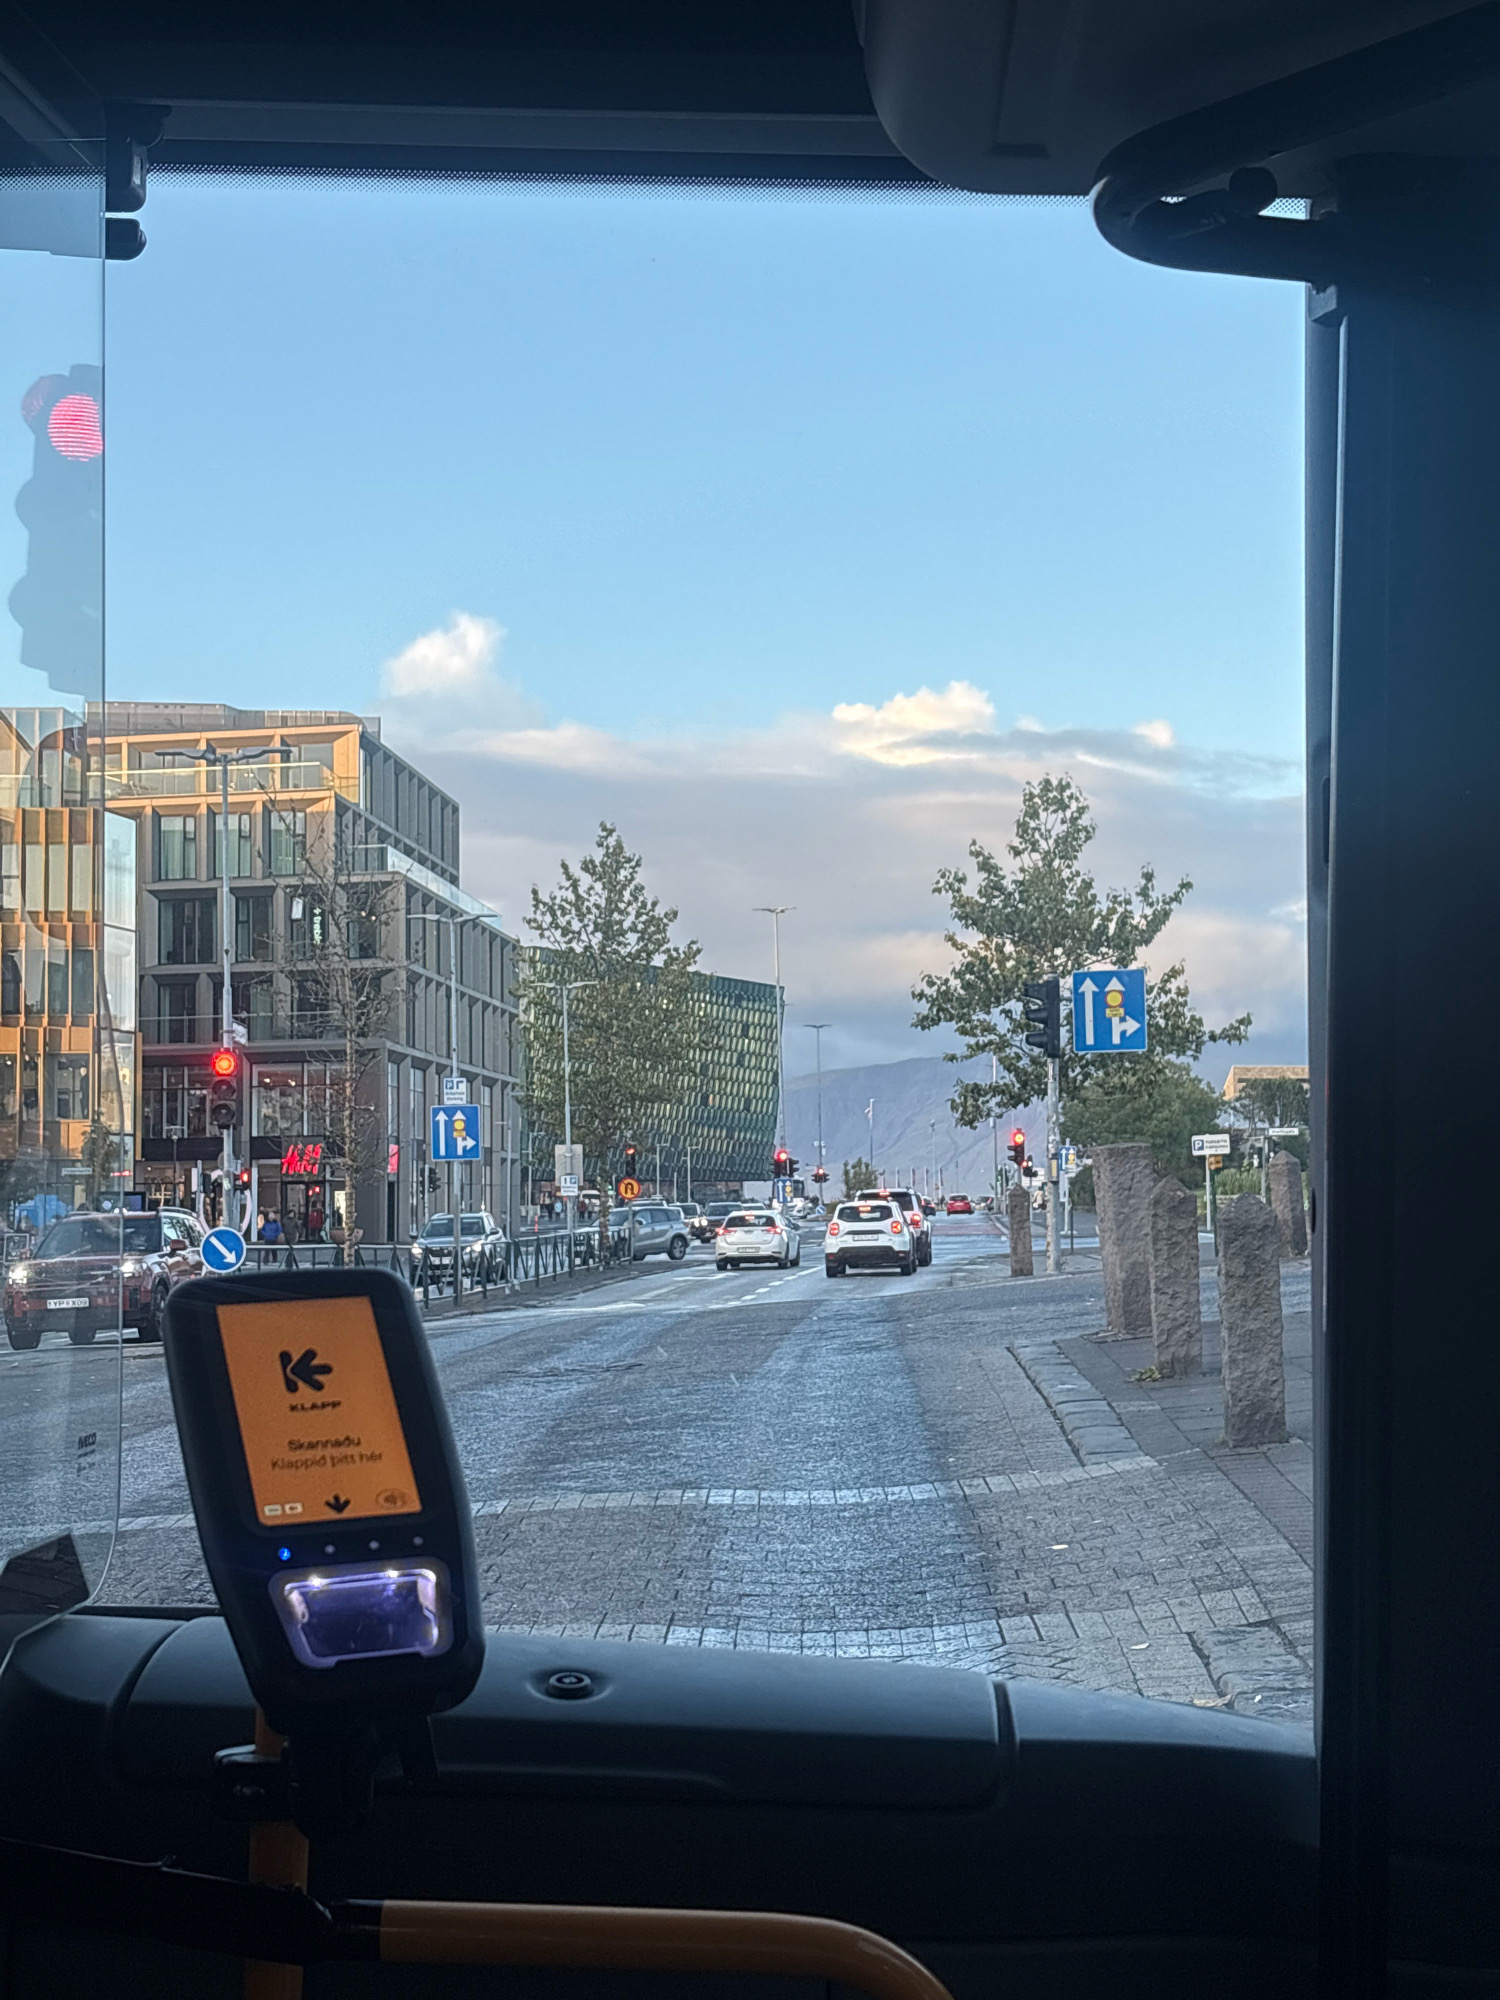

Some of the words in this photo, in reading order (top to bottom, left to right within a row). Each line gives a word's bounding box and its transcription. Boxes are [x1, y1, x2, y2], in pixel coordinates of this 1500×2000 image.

[281, 1143, 322, 1176] H&M
[289, 1400, 342, 1413] KLAPP
[78, 1432, 97, 1450] IVECO
[287, 1435, 361, 1452] Skannaðu
[270, 1454, 328, 1472] Klappið
[331, 1453, 357, 1468] þitt
[359, 1451, 384, 1464] hér
